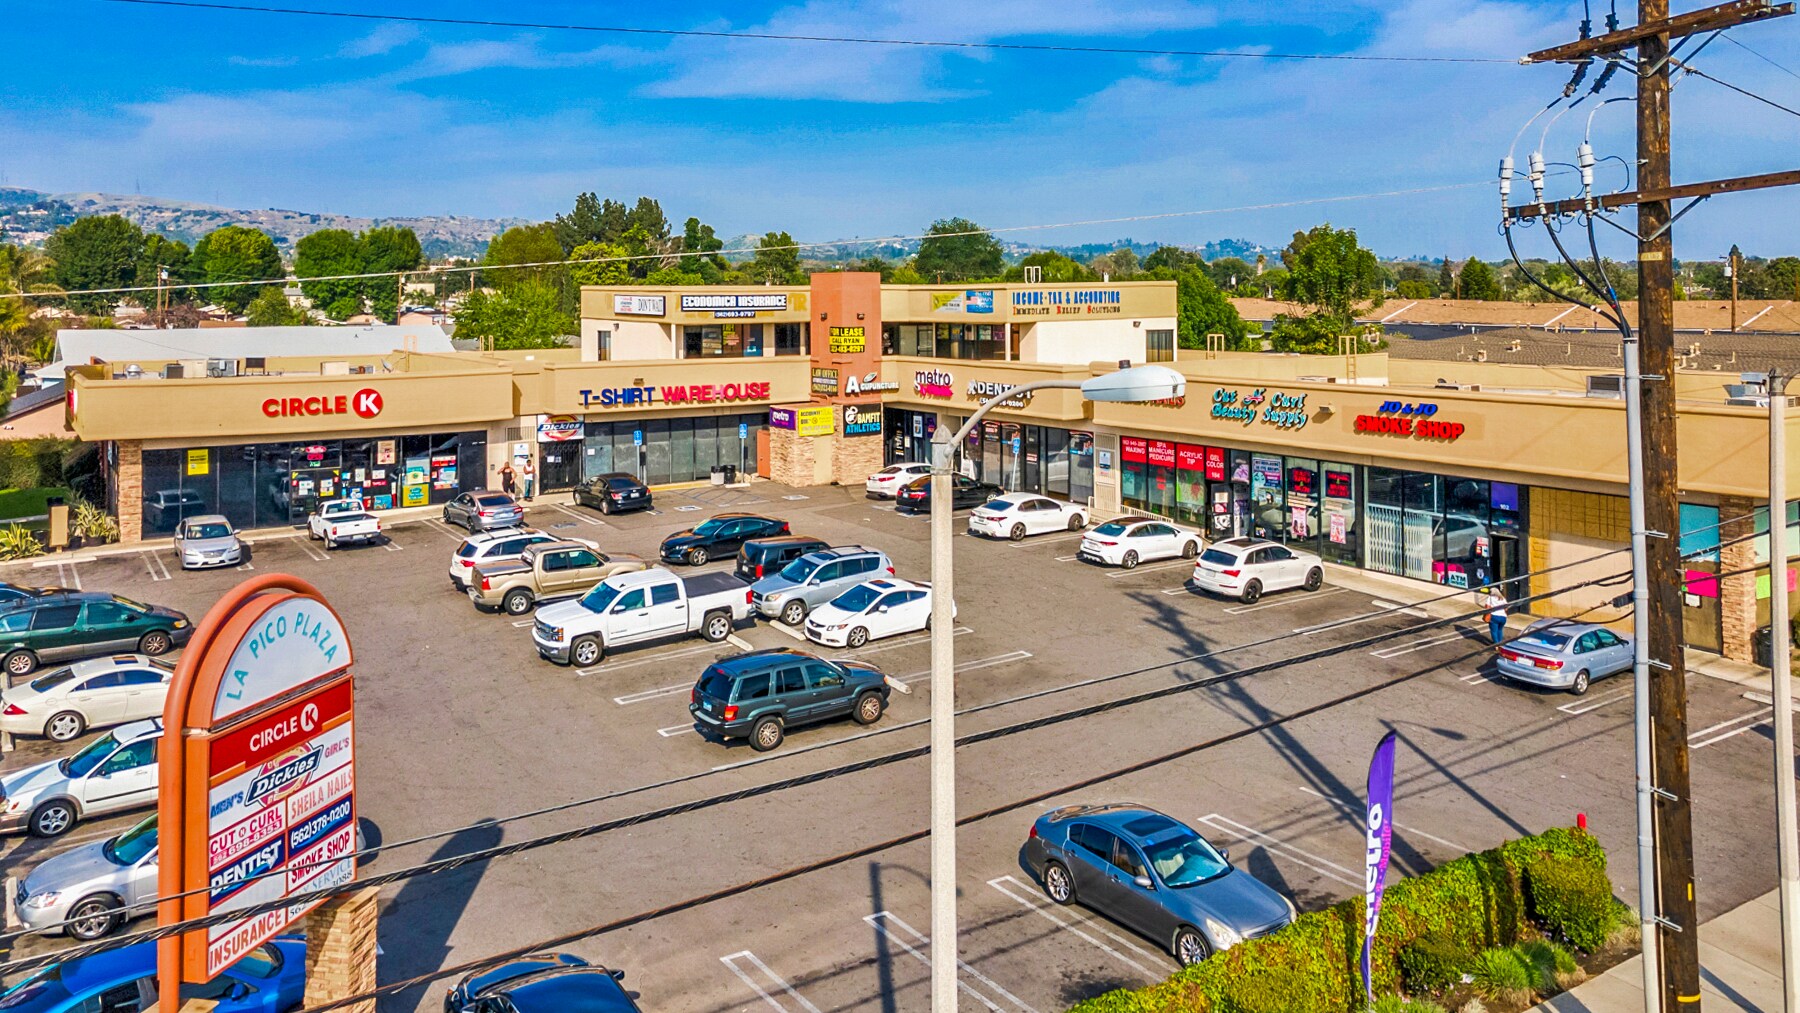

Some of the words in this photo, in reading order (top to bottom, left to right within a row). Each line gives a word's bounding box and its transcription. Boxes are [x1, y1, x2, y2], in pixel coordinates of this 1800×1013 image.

[683, 296, 736, 307] ECONOMICA
[738, 296, 786, 307] INSURANCE
[1066, 292, 1071, 304] &
[1074, 291, 1120, 304] ACCOUNTING
[1012, 306, 1050, 316] IMMEDIATE
[1056, 306, 1081, 315] RELIEF
[841, 327, 864, 336] LEASE
[915, 368, 952, 387] metro
[580, 386, 656, 406] T-SHIRT
[661, 382, 770, 403] WAREHOUSE
[1213, 387, 1238, 403] Cut
[1272, 392, 1307, 409] Curl
[262, 395, 347, 418] CIRCLE
[357, 391, 381, 417] K
[1379, 400, 1402, 413] JO
[1402, 403, 1414, 415] &
[1414, 403, 1438, 417] JO
[857, 412, 881, 424] BAMFIT
[1211, 403, 1257, 425] Beauty
[1262, 407, 1307, 429] Supply
[845, 423, 881, 434] ATHLETICS
[1356, 415, 1413, 436] SMOKE
[1416, 419, 1464, 440] SHOP
[1125, 446, 1145, 455] WAXING
[1148, 447, 1175, 456] MANICURE
[1156, 441, 1167, 449] SPA
[1148, 453, 1175, 463] PEDICURE
[1179, 450, 1203, 460] ACRYLIC
[1209, 453, 1220, 462] GEL
[1206, 461, 1224, 469] COLOR
[1450, 574, 1466, 582] ATM
[226, 669, 249, 701] LA
[249, 615, 287, 659] PICO
[294, 612, 338, 663] PLAZA
[249, 715, 298, 752] CIRCLE
[303, 705, 317, 731] K
[252, 755, 316, 797] Dickies
[324, 737, 350, 759] GIRL'S
[291, 786, 324, 820] SHEILA
[327, 769, 353, 799] NAILS
[210, 829, 237, 855] CUT
[249, 807, 282, 834] CURL
[290, 800, 351, 850] (562)378-0200
[291, 846, 323, 884] SMOKE
[327, 831, 351, 860] SHOP
[210, 840, 282, 897] DENTIST
[208, 909, 282, 971] INSURANCE
